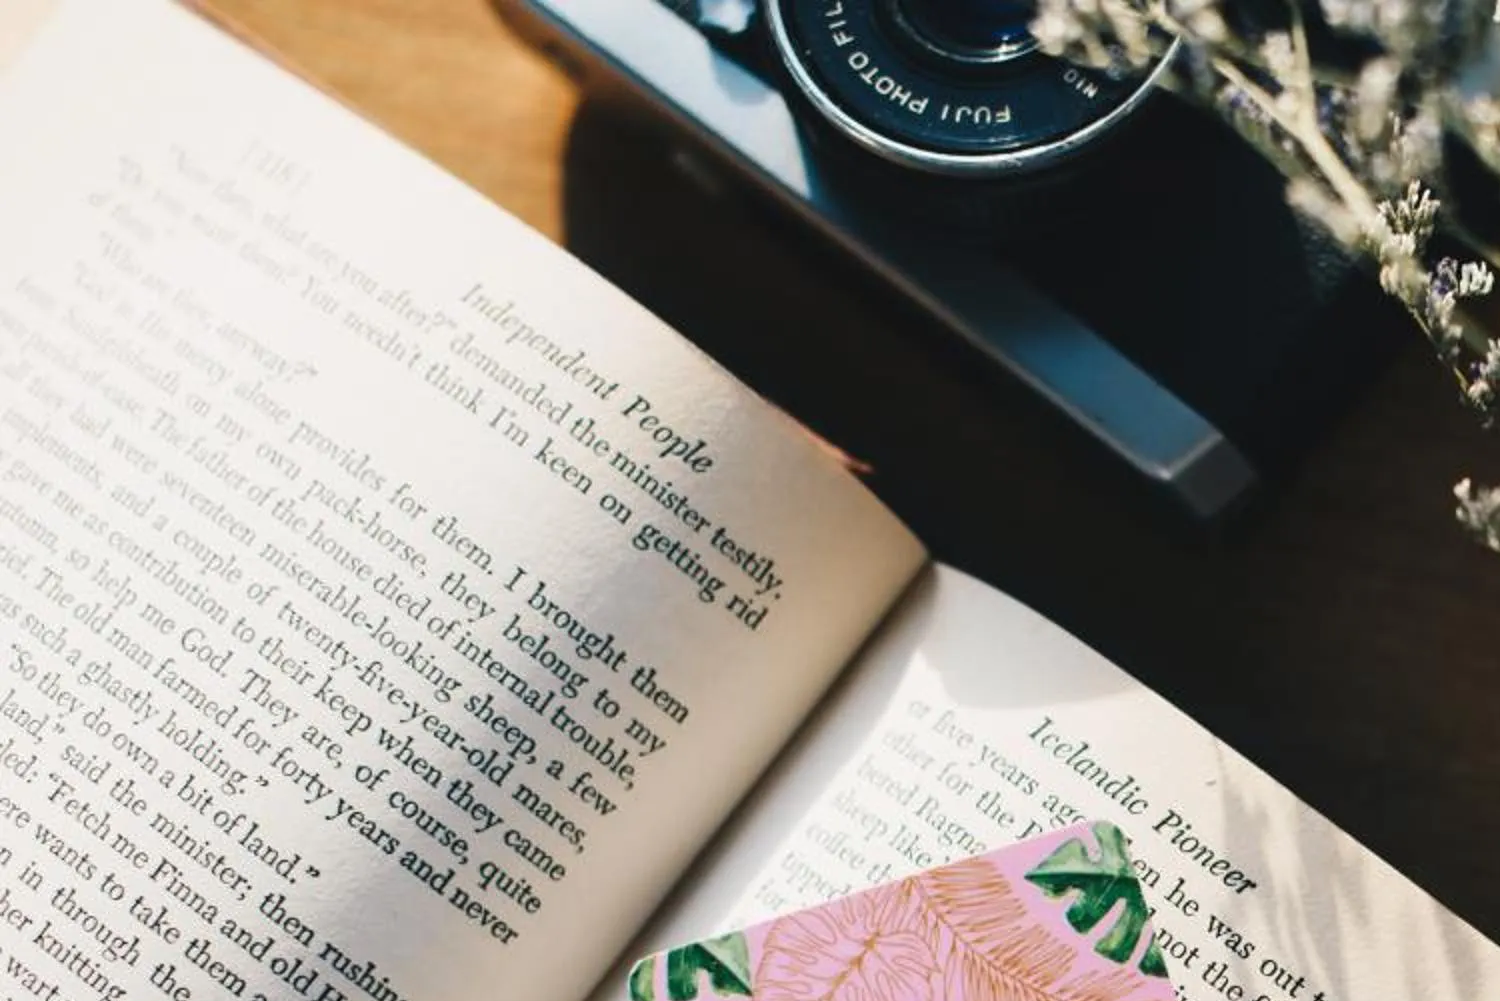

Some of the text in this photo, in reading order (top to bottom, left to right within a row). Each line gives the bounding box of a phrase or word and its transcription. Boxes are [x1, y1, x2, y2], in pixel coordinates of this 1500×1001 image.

[847, 50, 930, 117] PHOTO
[940, 104, 1012, 126] FUJI
[460, 283, 713, 473] Independent People
[449, 332, 783, 600] demanded the minister testily.
[534, 437, 769, 631] keen getting rid
[258, 543, 537, 765] miserable-looking sheep,
[431, 516, 689, 724] them. brought them
[502, 613, 590, 699] belong
[277, 601, 586, 854] twenty-five-year-old mares,
[313, 674, 566, 881] keep when came
[453, 631, 635, 790] internal trouble,
[270, 746, 519, 945] forty years never
[388, 791, 541, 914] course, quite
[980, 744, 1039, 795] years
[1163, 877, 1199, 917] he
[1207, 915, 1256, 960] was
[1259, 959, 1305, 999] out
[1028, 717, 1258, 895] Icelandic Pioneer
[51, 887, 140, 967] through
[129, 895, 180, 945] take
[184, 938, 247, 998] them
[149, 857, 218, 925] Finna
[269, 957, 320, 997] old
[259, 892, 315, 948] then
[1159, 928, 1200, 969] not
[1201, 961, 1244, 1001] the
